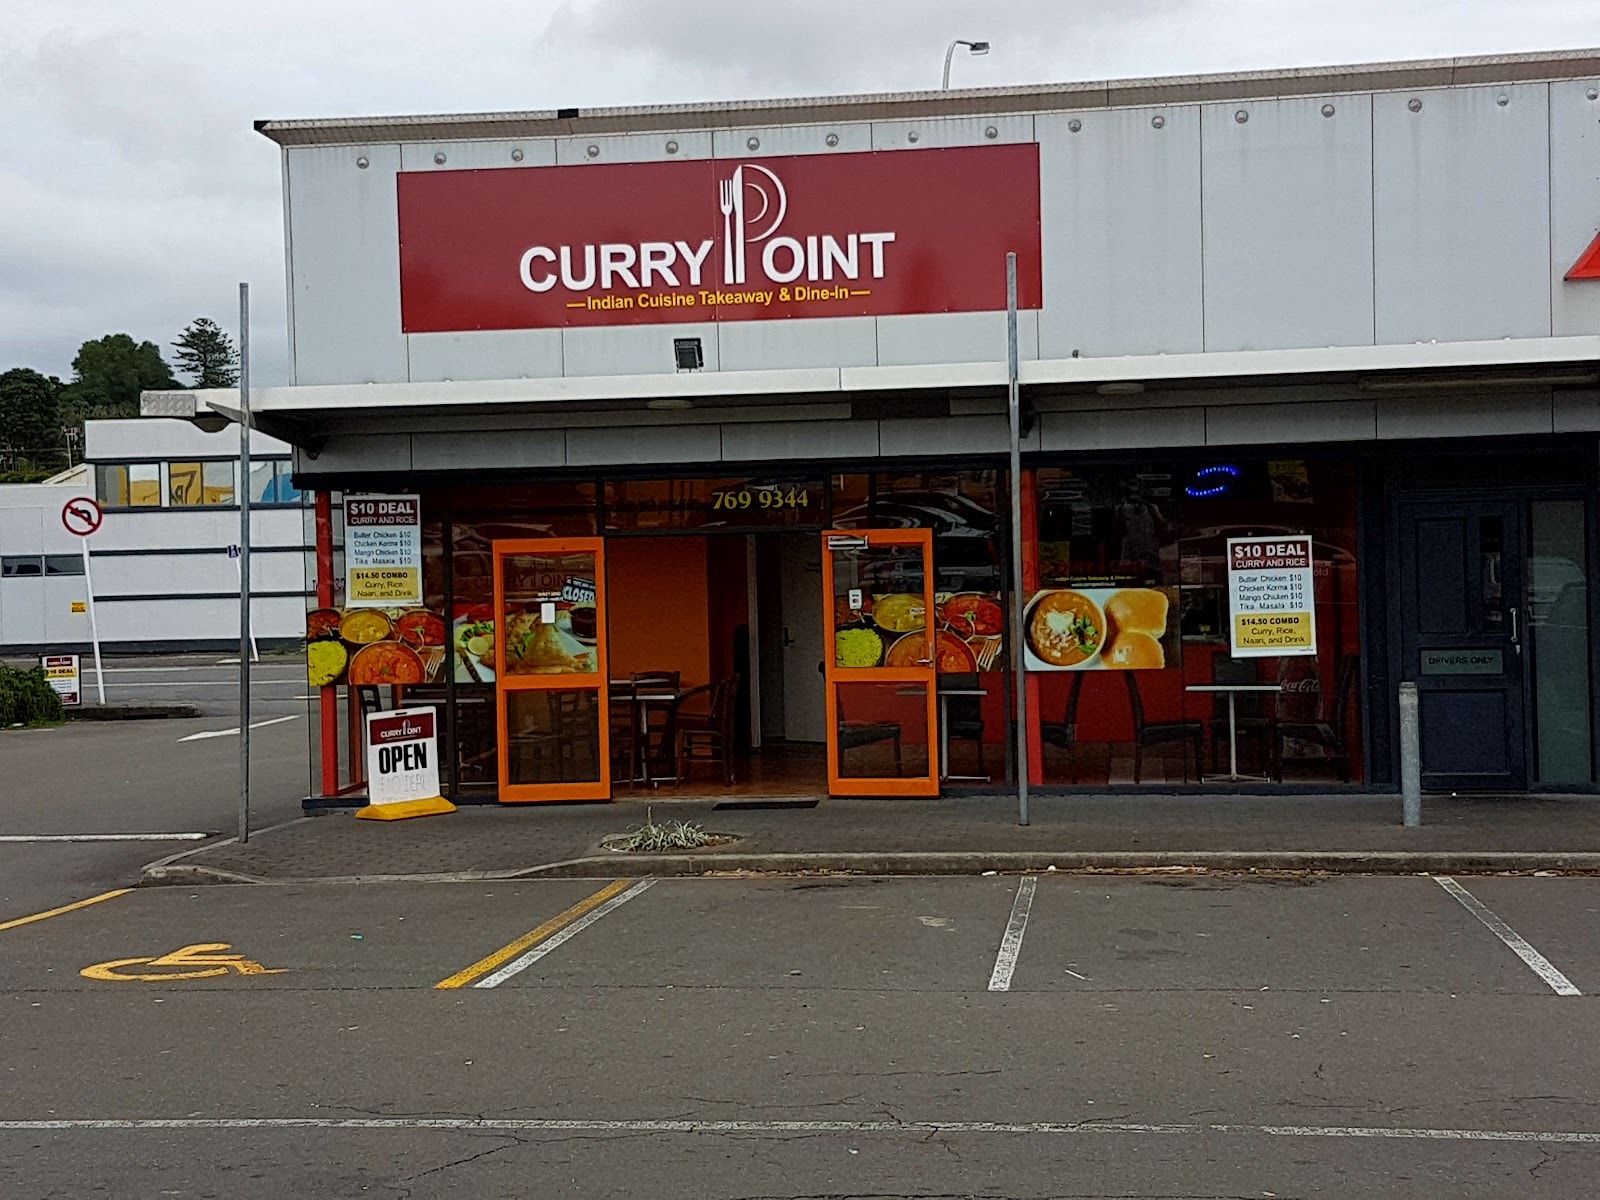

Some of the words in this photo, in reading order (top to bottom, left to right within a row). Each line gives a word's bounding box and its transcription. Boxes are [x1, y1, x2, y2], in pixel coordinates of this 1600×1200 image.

[519, 240, 714, 292] CURRY
[720, 164, 896, 284] POINT
[587, 295, 634, 310] Indian
[638, 292, 696, 307] Cuisine
[698, 290, 773, 306] Takeaway
[779, 286, 791, 302] &
[712, 491, 752, 509] 769
[759, 487, 808, 508] 9344
[350, 502, 375, 515] $10
[378, 502, 415, 514] DEAL
[351, 516, 378, 525] CURRY
[378, 516, 395, 524] AND
[396, 516, 415, 524] RICE
[399, 530, 411, 538] $10
[399, 539, 411, 547] $10
[399, 548, 412, 556] $10
[1235, 545, 1262, 558] $10
[1266, 543, 1306, 556] DEAL
[399, 556, 412, 564] $10
[1236, 559, 1264, 569] CURRY
[1265, 558, 1285, 567] AND
[1285, 557, 1306, 567] RICE
[381, 571, 408, 579] COMBO
[1260, 574, 1287, 582] Chicken
[1289, 573, 1302, 582] $10
[1238, 584, 1265, 592] Chicken
[1290, 583, 1303, 591] $10
[563, 584, 595, 603] CLOSED
[1239, 594, 1262, 602] Mango
[1290, 592, 1303, 600] $10
[1290, 601, 1304, 609] $10
[1241, 618, 1268, 626] $14.50
[1269, 617, 1300, 625] COMBO
[1268, 636, 1283, 644] and
[1284, 635, 1305, 643] Drink
[1470, 656, 1494, 664] ONLY
[378, 742, 428, 774] OPEN
